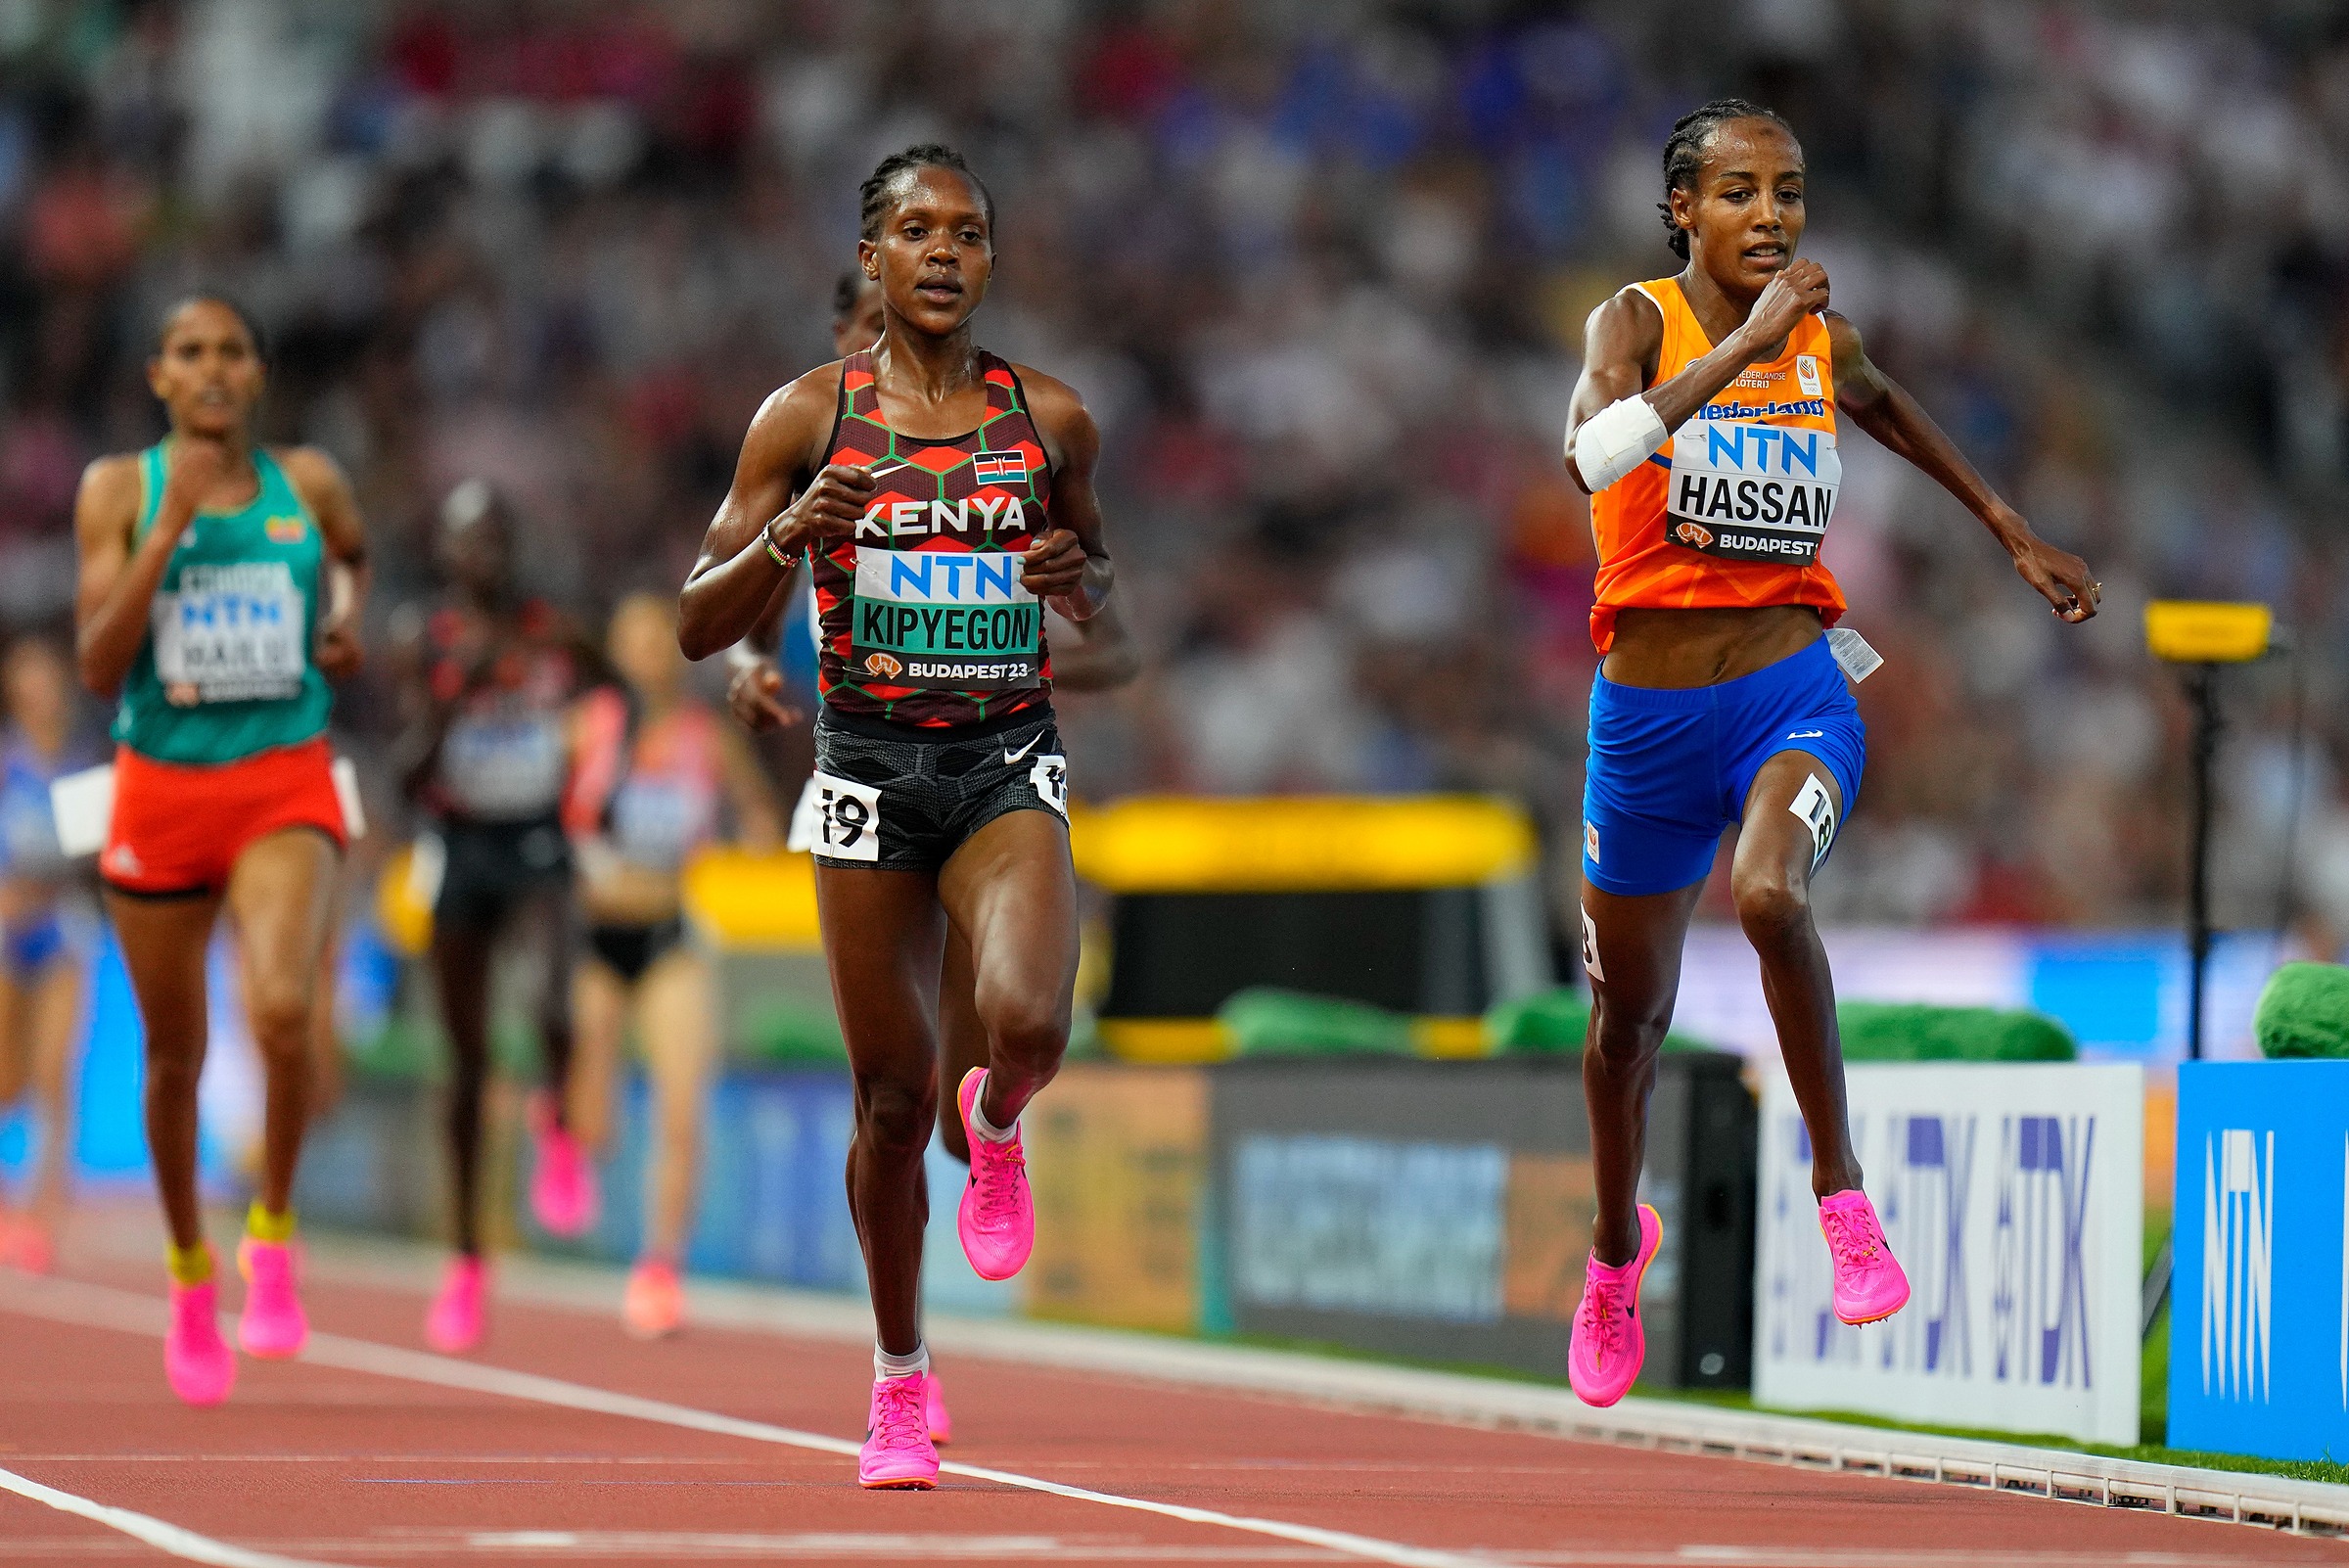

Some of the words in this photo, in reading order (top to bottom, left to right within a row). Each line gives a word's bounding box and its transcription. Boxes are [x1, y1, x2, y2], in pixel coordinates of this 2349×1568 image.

[1735, 378, 1770, 389] LOTERIJ
[1709, 424, 1817, 478] NTN
[855, 497, 1026, 538] KENYA
[1679, 475, 1831, 529] HASSAN
[890, 554, 1012, 599] NTN
[863, 603, 1031, 650] KIPYEGON
[822, 789, 869, 847] 19
[1809, 789, 1831, 857] 18
[2201, 1130, 2274, 1405] NTN
